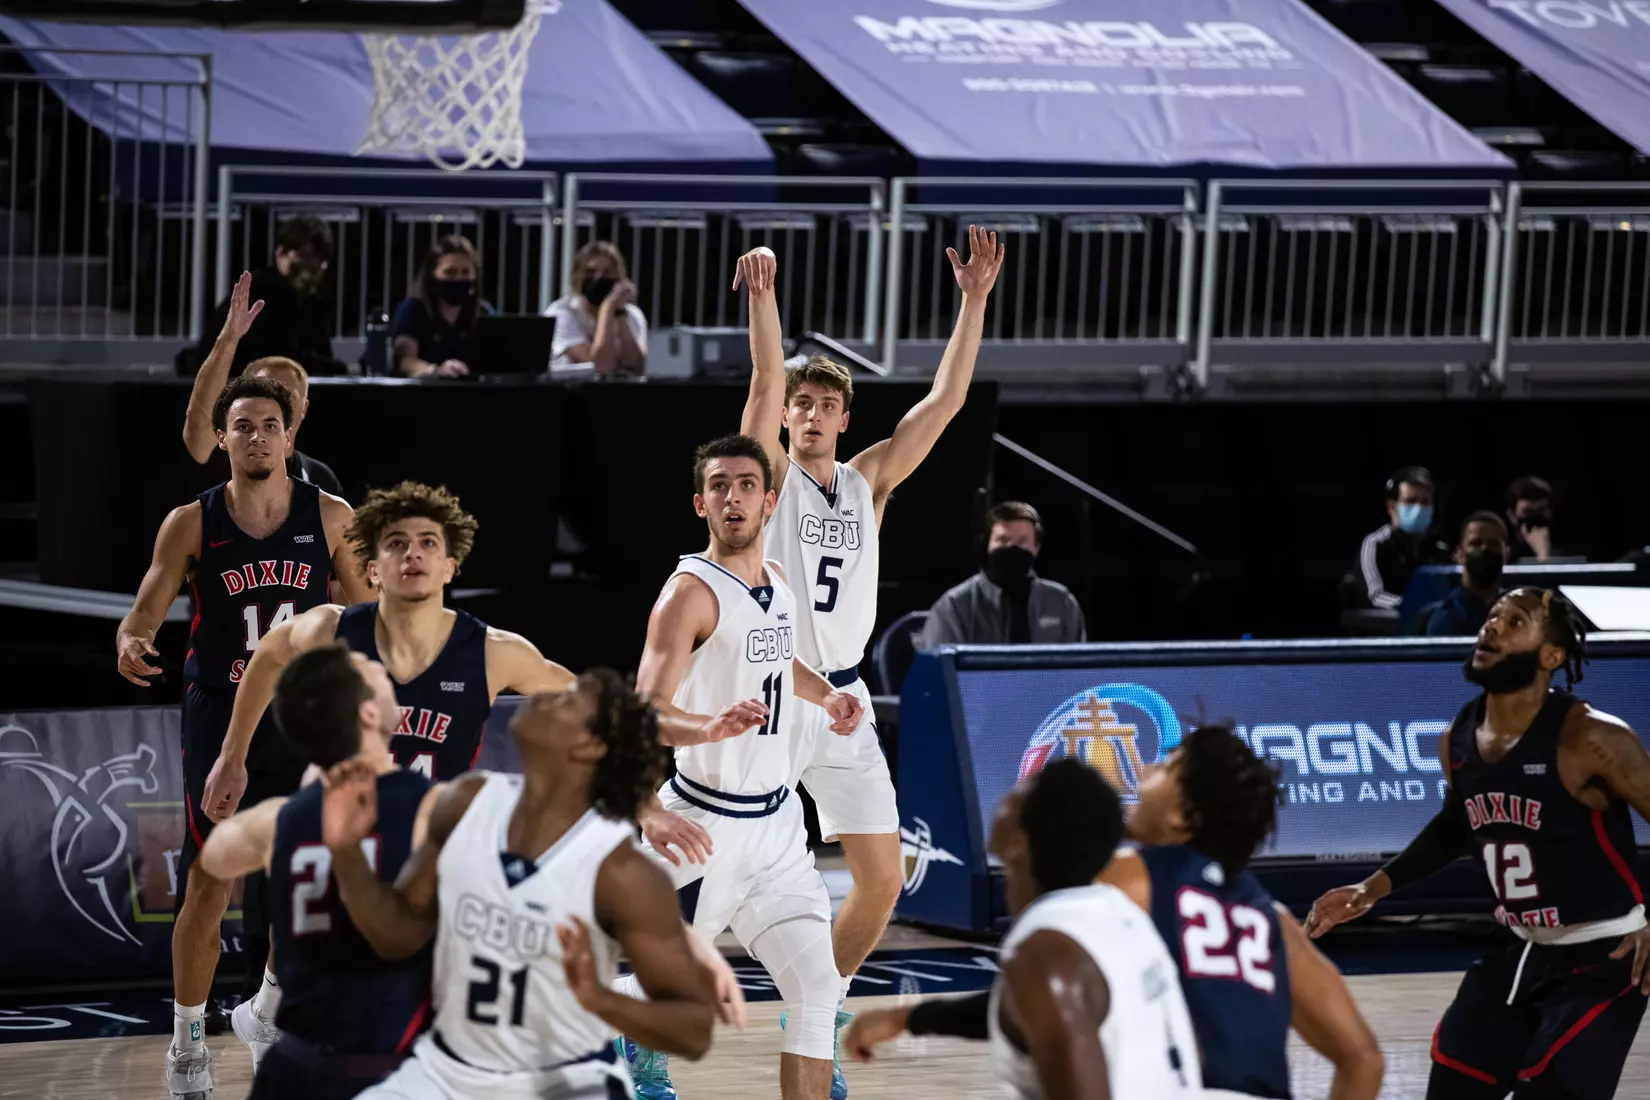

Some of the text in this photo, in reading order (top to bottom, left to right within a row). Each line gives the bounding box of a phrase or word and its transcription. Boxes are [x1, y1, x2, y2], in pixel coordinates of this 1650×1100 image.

[853, 15, 1279, 50] MAGNOLIA
[799, 513, 860, 550] CBU
[841, 509, 854, 517] WAC
[294, 534, 314, 543] WAC
[221, 559, 312, 596] DIXIE
[814, 555, 844, 613] 5
[746, 625, 794, 662] CBU
[758, 671, 783, 735] 11
[392, 705, 452, 744] XIE
[1190, 720, 1450, 776] AGNO
[1277, 782, 1344, 803] ING
[1357, 779, 1426, 802] AND
[1464, 792, 1542, 831] DIXIE
[1482, 839, 1539, 901] 12
[455, 892, 551, 959] CBU
[1176, 885, 1276, 995] 22
[466, 954, 530, 1027] 21
